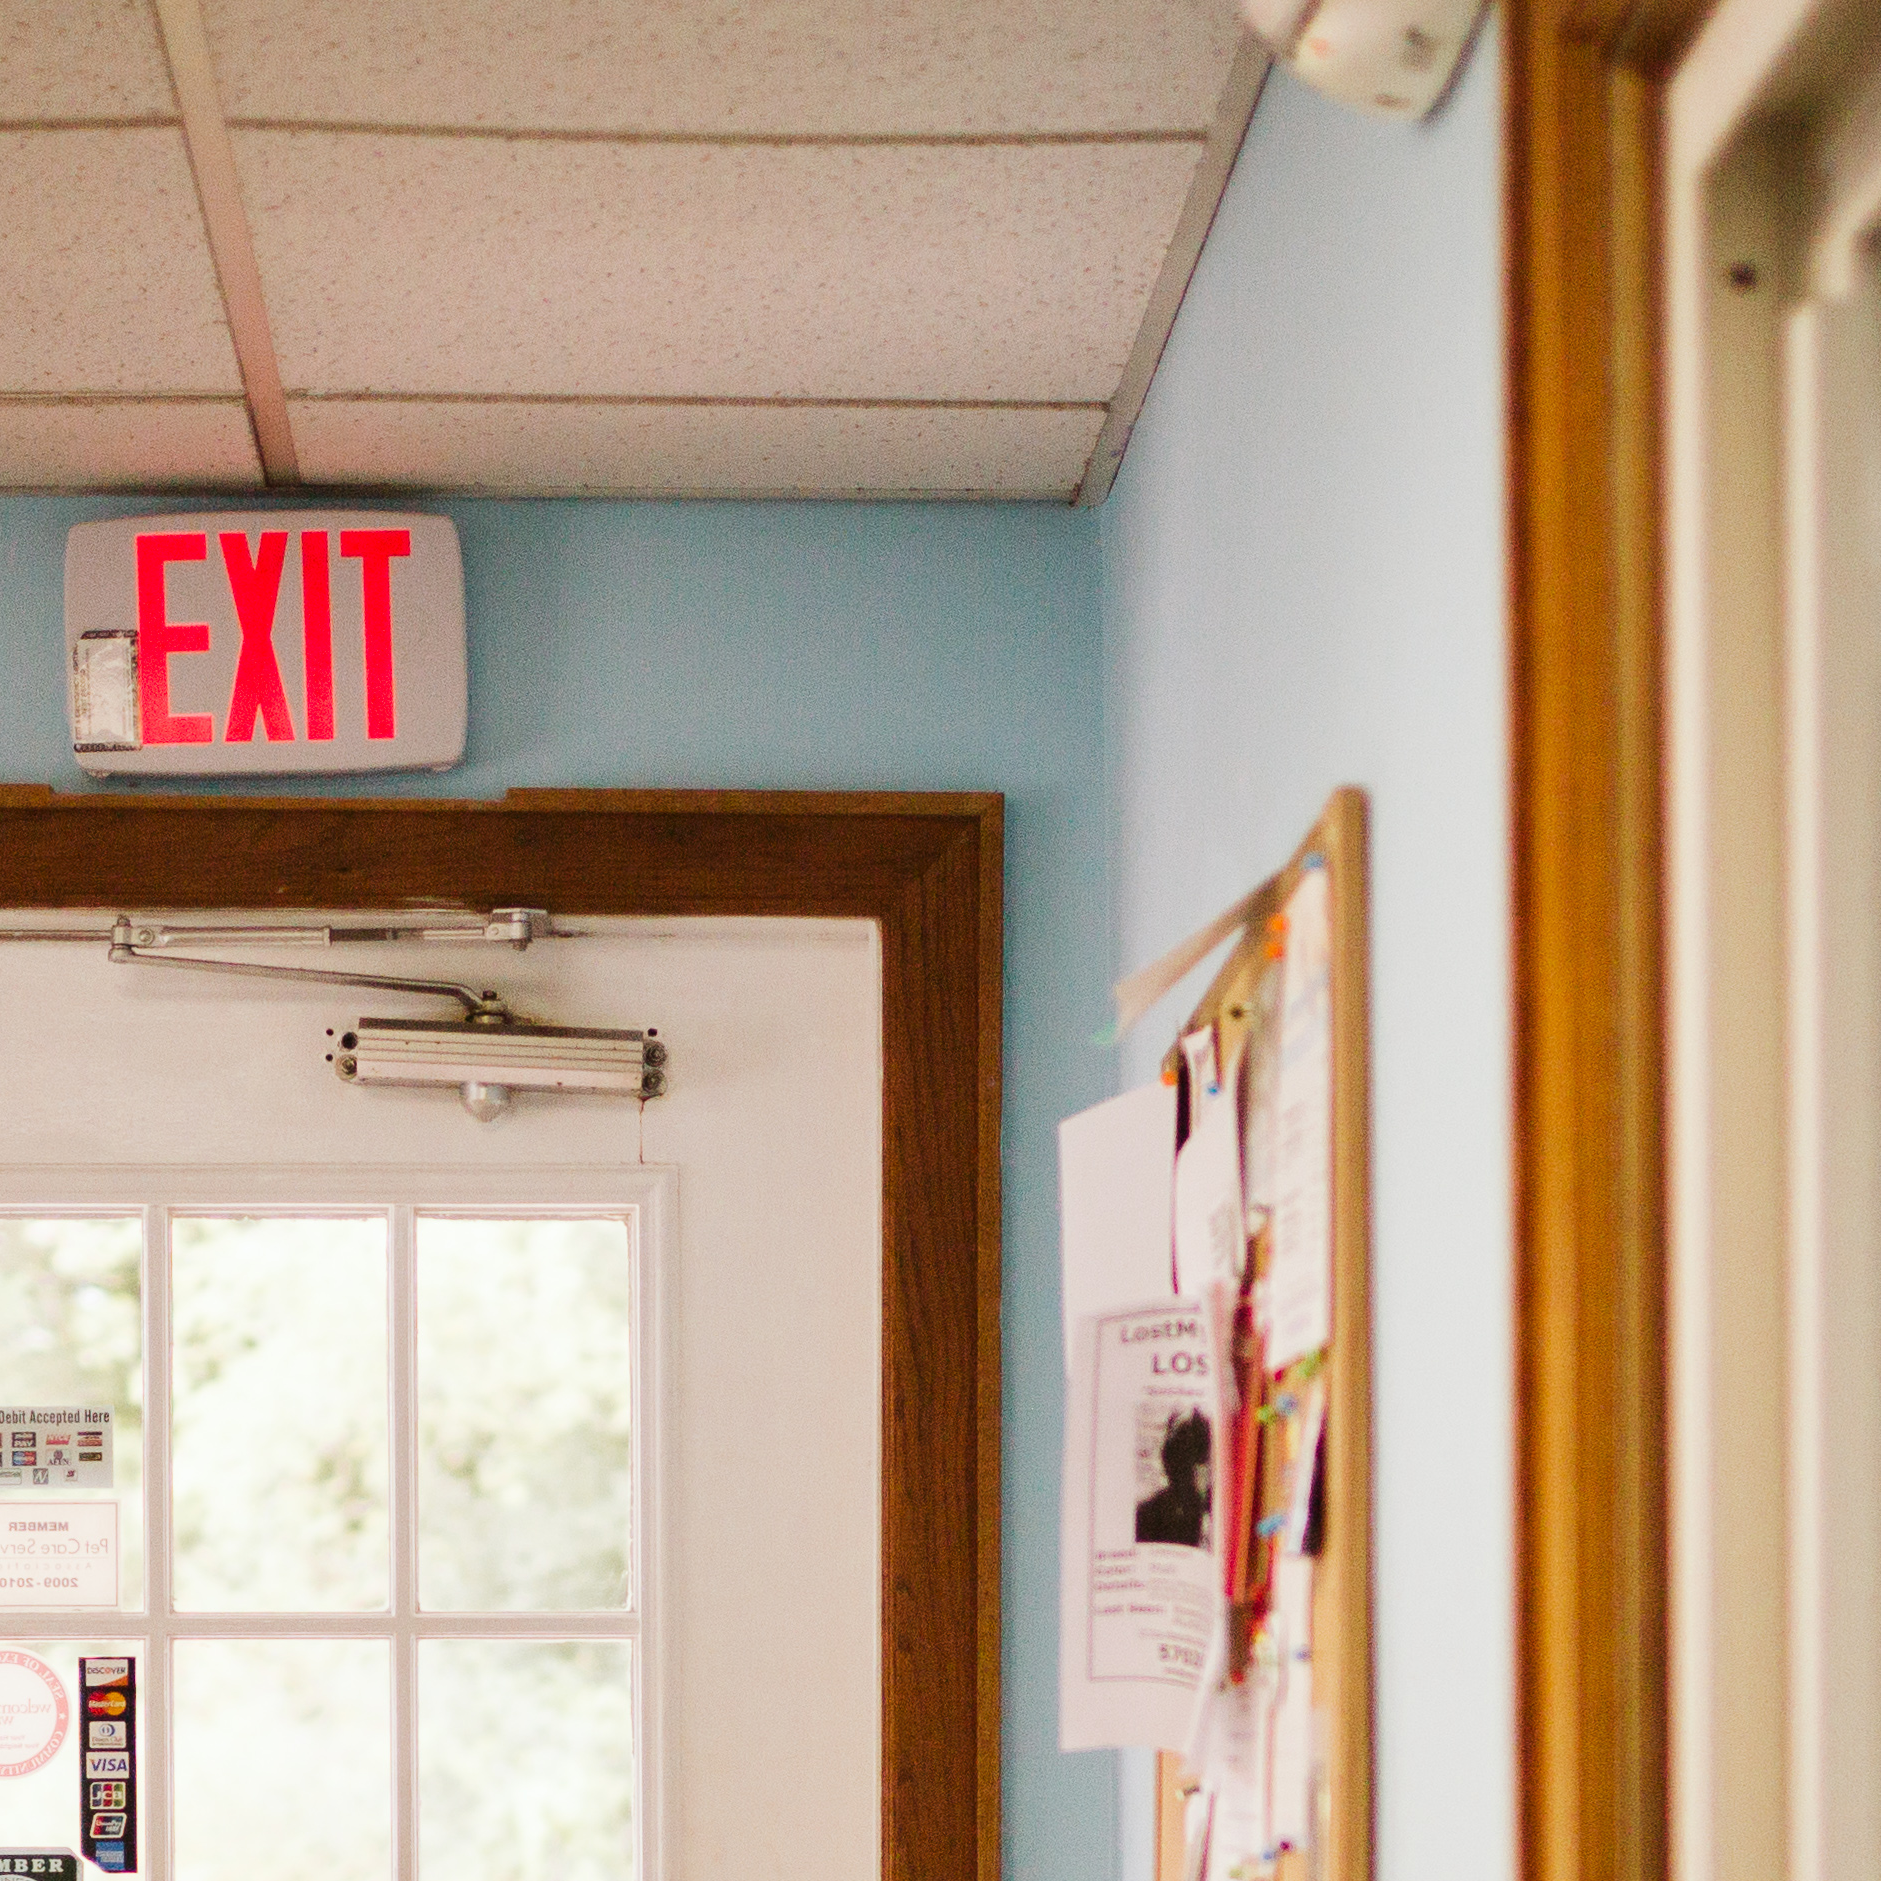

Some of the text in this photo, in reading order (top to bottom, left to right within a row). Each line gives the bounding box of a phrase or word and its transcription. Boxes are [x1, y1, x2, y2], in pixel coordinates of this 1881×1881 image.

[135, 529, 411, 744] EXIT
[29, 1409, 80, 1426] Accepted
[84, 1409, 110, 1423] Here
[87, 1666, 126, 1675] DISCOVER
[89, 1758, 128, 1771] VISA
[92, 1790, 124, 1800] JCB
